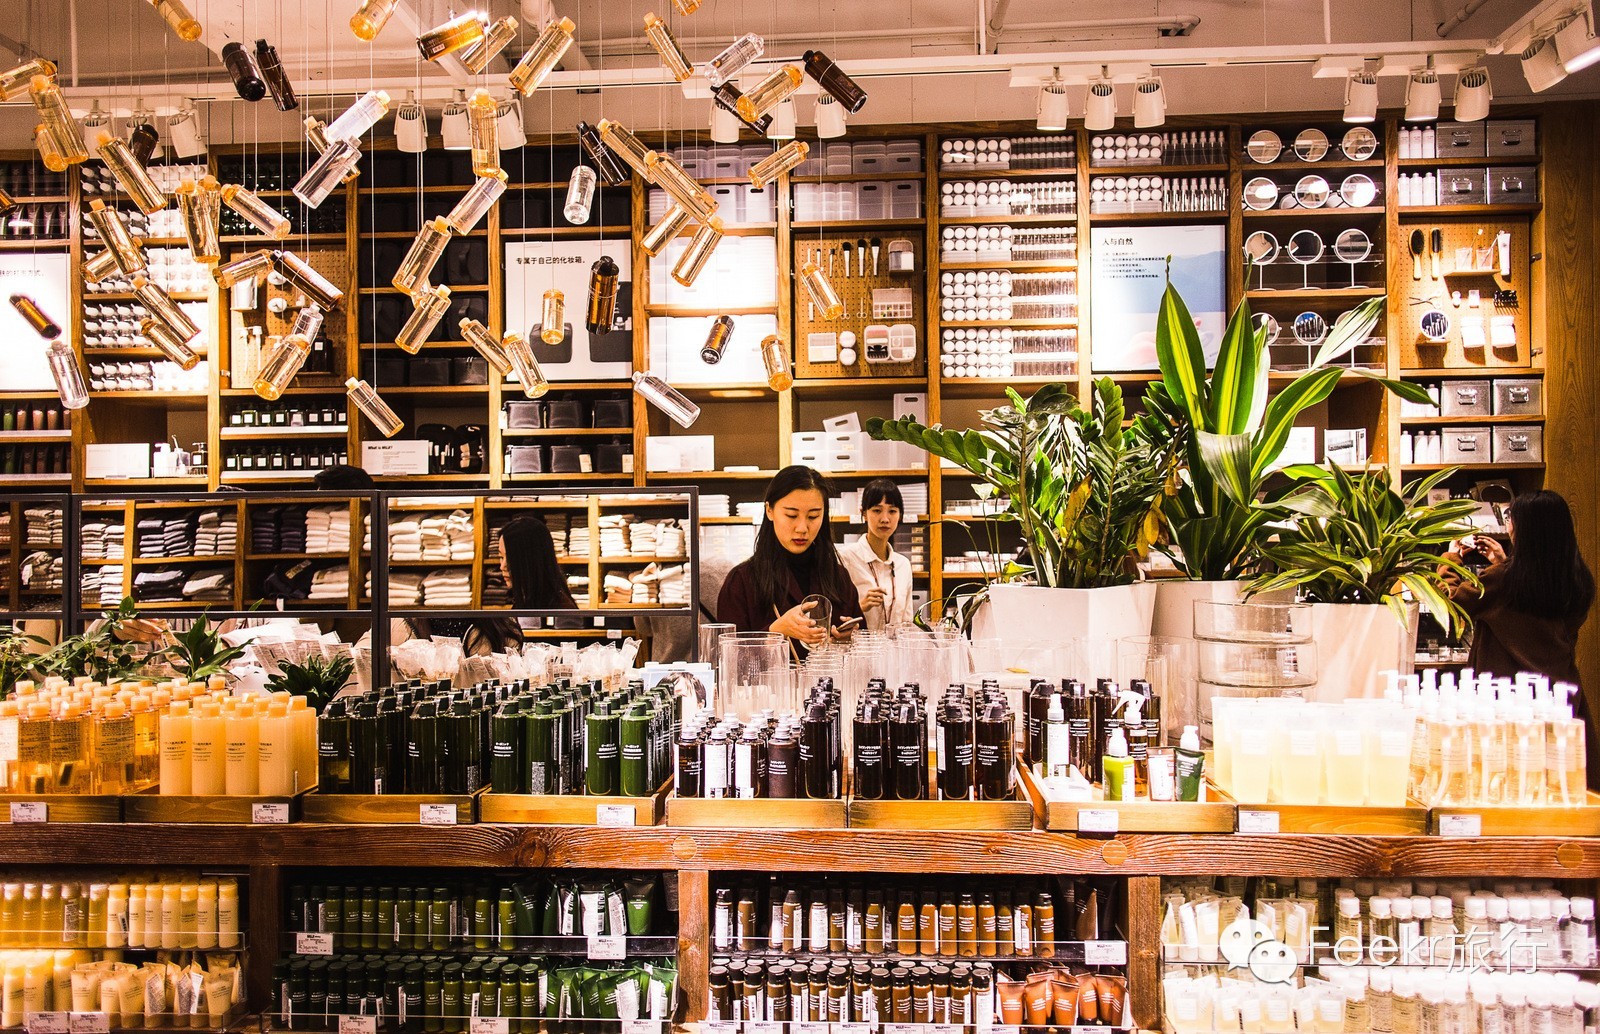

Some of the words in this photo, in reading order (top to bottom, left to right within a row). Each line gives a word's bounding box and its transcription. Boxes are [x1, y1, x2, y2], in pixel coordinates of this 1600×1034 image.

[1102, 238, 1133, 246] 人与自然
[516, 256, 585, 265] 专属于自己的化妆箱。
